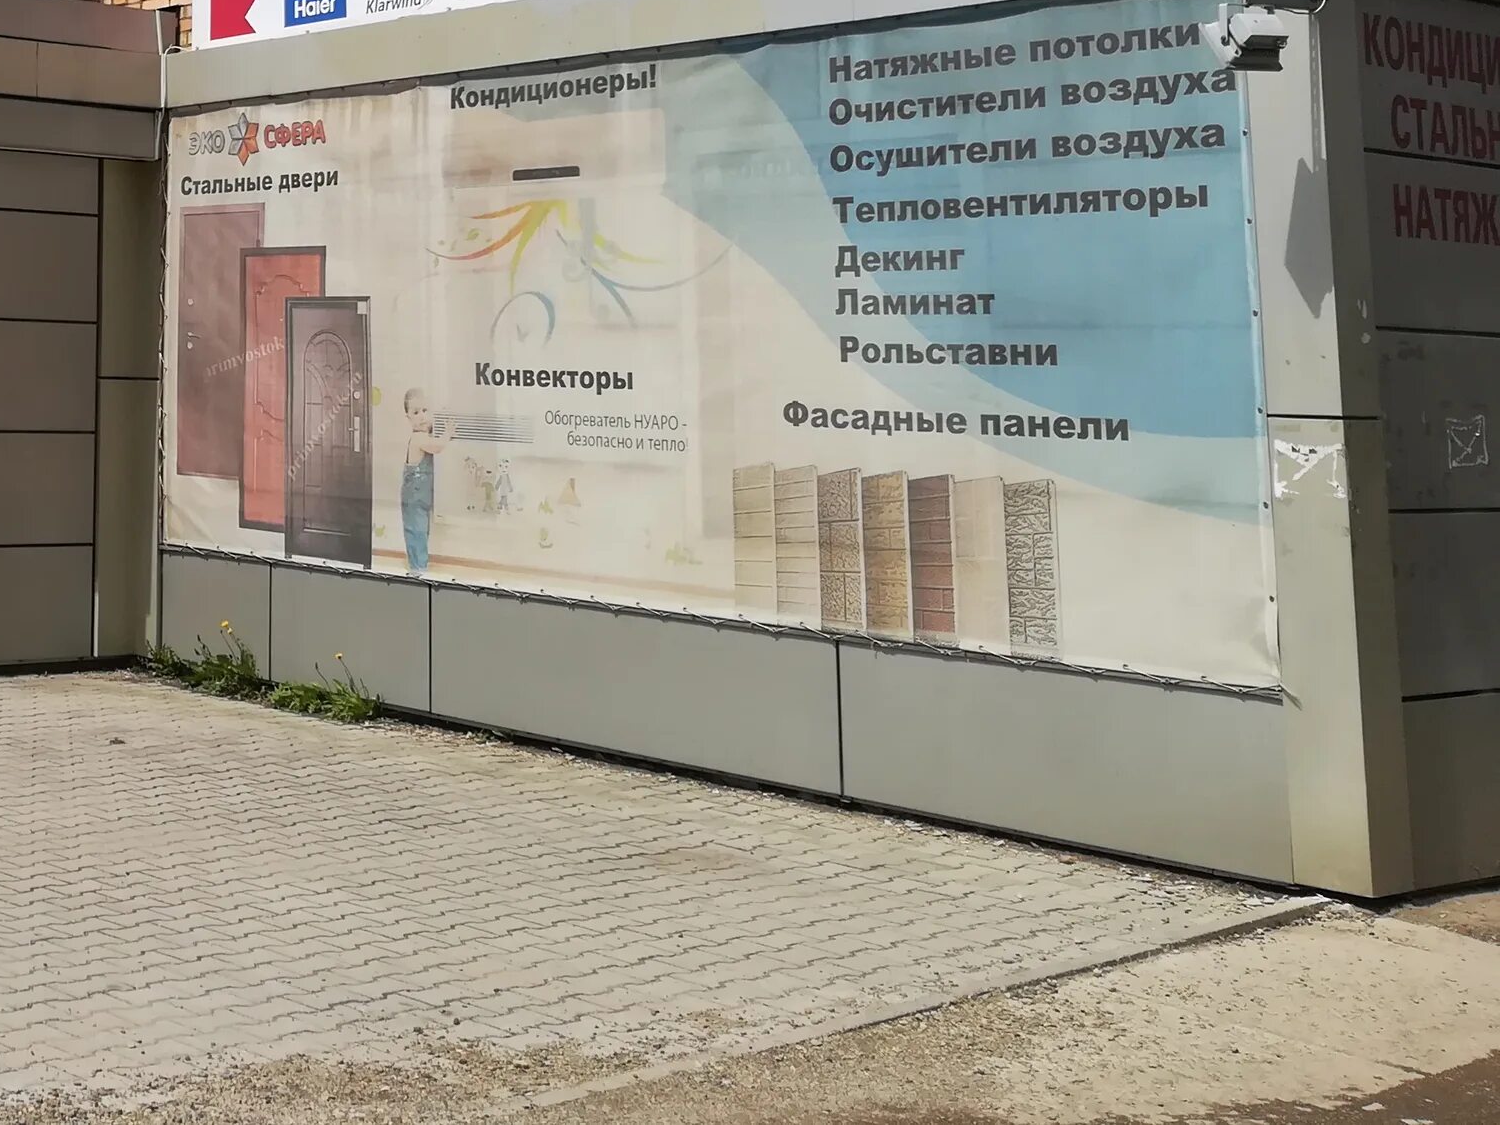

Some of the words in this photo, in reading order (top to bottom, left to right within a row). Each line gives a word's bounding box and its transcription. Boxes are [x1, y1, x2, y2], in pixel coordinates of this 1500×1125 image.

[828, 43, 1016, 83] Натяжные
[1029, 22, 1201, 62] потолки
[450, 64, 658, 110] Кондиционеры!
[828, 86, 1046, 125] Очистители
[1061, 68, 1238, 106] воздуха
[189, 129, 225, 156] ЭКО
[263, 119, 327, 150] СФЕРА
[829, 137, 1037, 176] Осушители
[1051, 122, 1226, 159] воздуха
[180, 174, 273, 197] Стальные
[278, 167, 340, 193] двери
[832, 184, 1209, 224] Тепловентиляторы
[834, 245, 966, 278] Декинг
[835, 288, 996, 316] Ламинат
[839, 336, 1059, 367] Рольставни
[474, 362, 634, 395] Конвекторы
[544, 409, 632, 433] Обогреватель
[634, 414, 679, 431] НУАРО
[782, 400, 967, 437] Фасадные
[979, 413, 1130, 442] панели
[566, 430, 633, 449] безопасно
[635, 439, 644, 450] и
